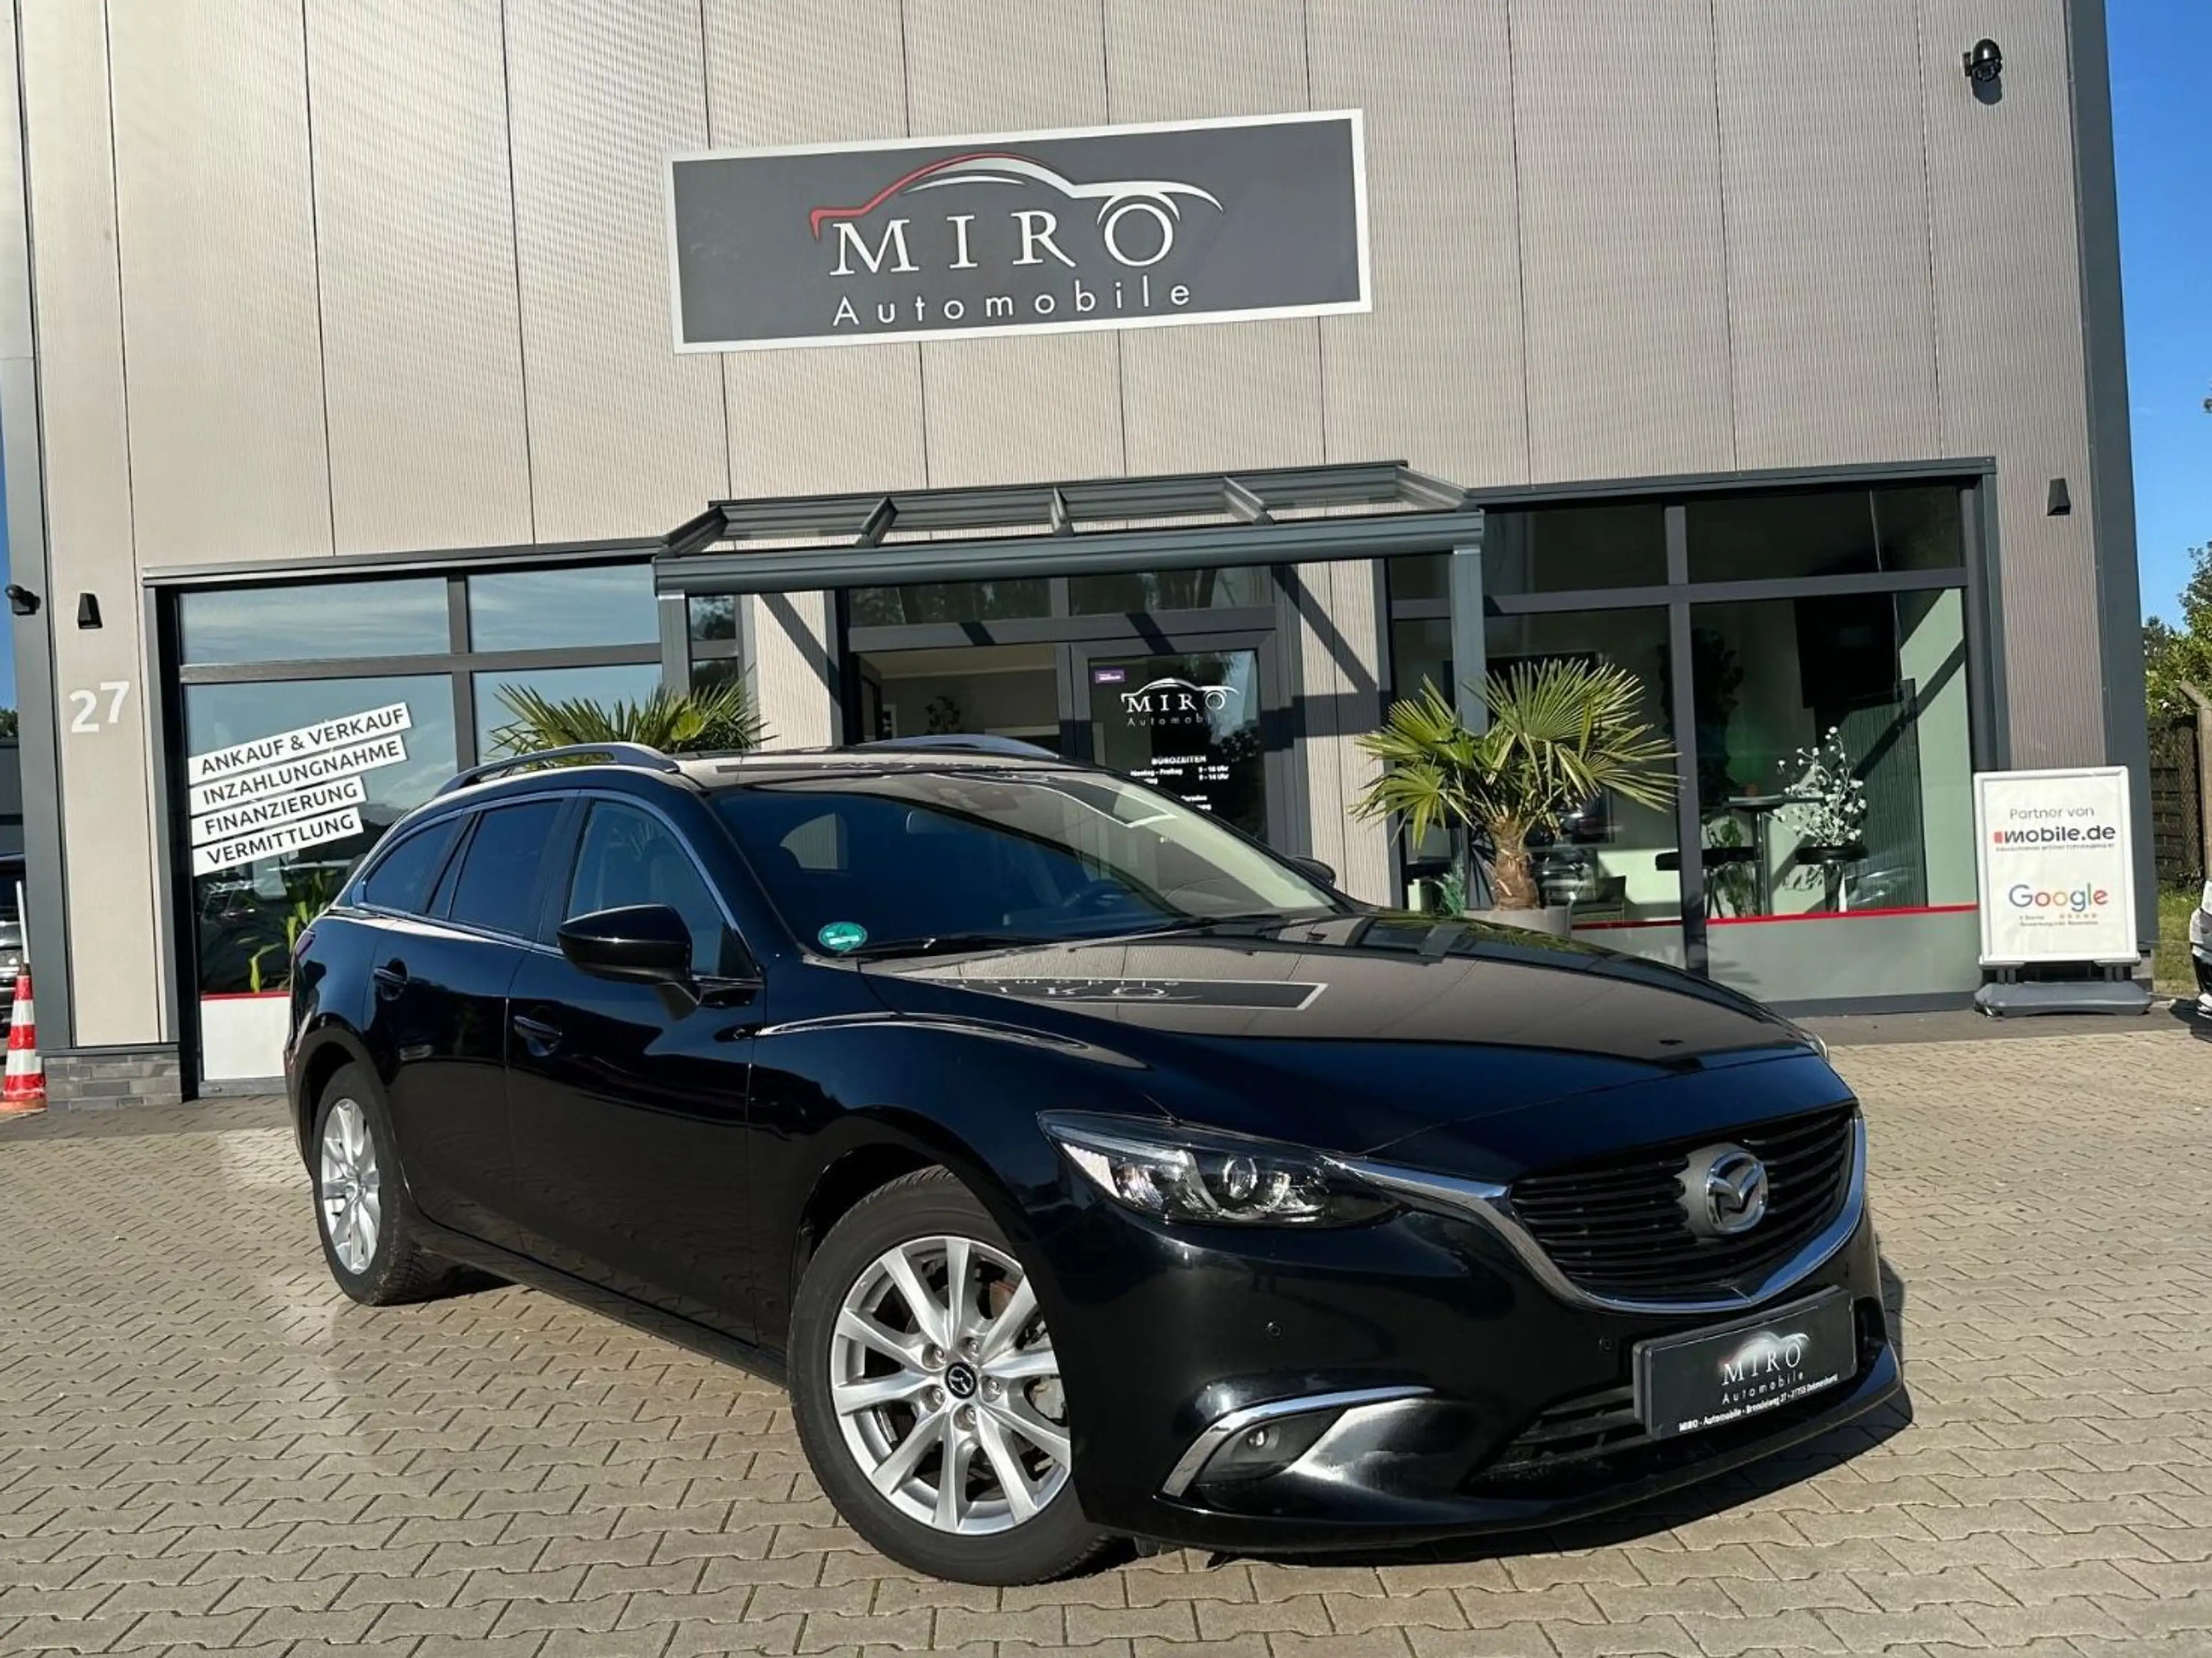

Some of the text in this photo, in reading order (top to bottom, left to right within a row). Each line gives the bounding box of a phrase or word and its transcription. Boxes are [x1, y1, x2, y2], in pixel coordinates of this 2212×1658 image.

[829, 203, 1173, 277] MIRO
[832, 274, 1191, 327] Automobile
[69, 681, 130, 733] 27
[1126, 691, 1225, 713] MIRO
[201, 707, 404, 775] ANKAUF & VERKAUF
[203, 740, 400, 805] INZAHLUNGNAHME
[205, 781, 358, 835] FINANZIERUNG
[2005, 825, 2116, 843] mobile.de
[2010, 807, 2094, 820] Partner von
[207, 813, 355, 866] VERMITTLUNG
[2009, 883, 2108, 913] Google
[1722, 1342, 1801, 1386] MIRO
[1722, 1370, 1804, 1405] Automobile
